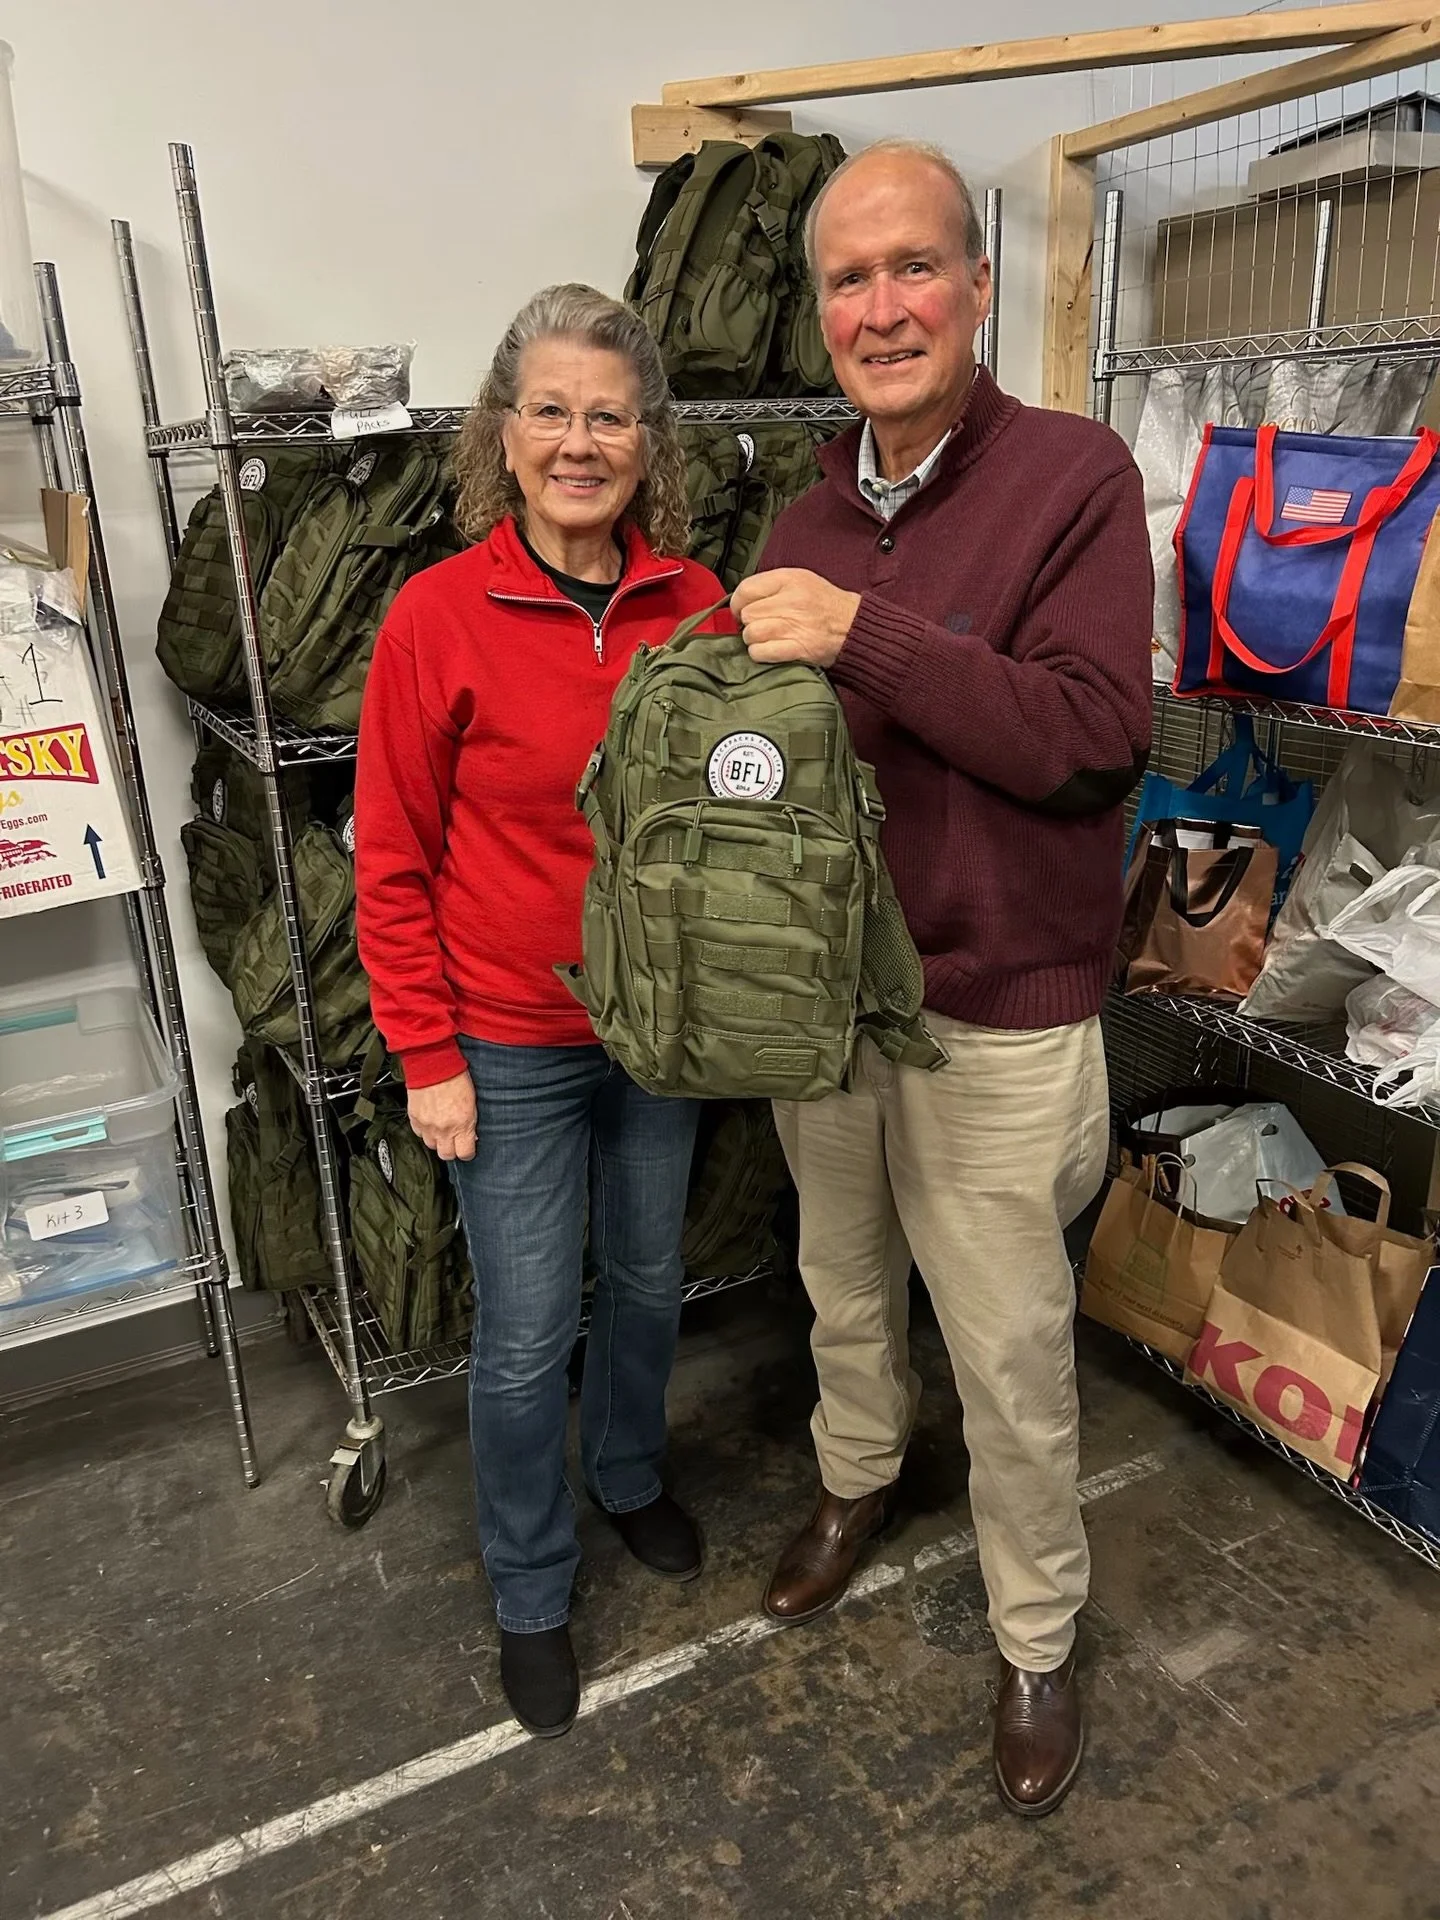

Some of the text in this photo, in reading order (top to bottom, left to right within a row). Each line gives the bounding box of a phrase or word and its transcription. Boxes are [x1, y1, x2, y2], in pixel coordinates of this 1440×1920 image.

[713, 736, 782, 773] BACKPACKS FOR LIFE
[730, 760, 765, 785] BFL
[0, 873, 73, 900] RIGERATED
[46, 1205, 83, 1229] Kit 3
